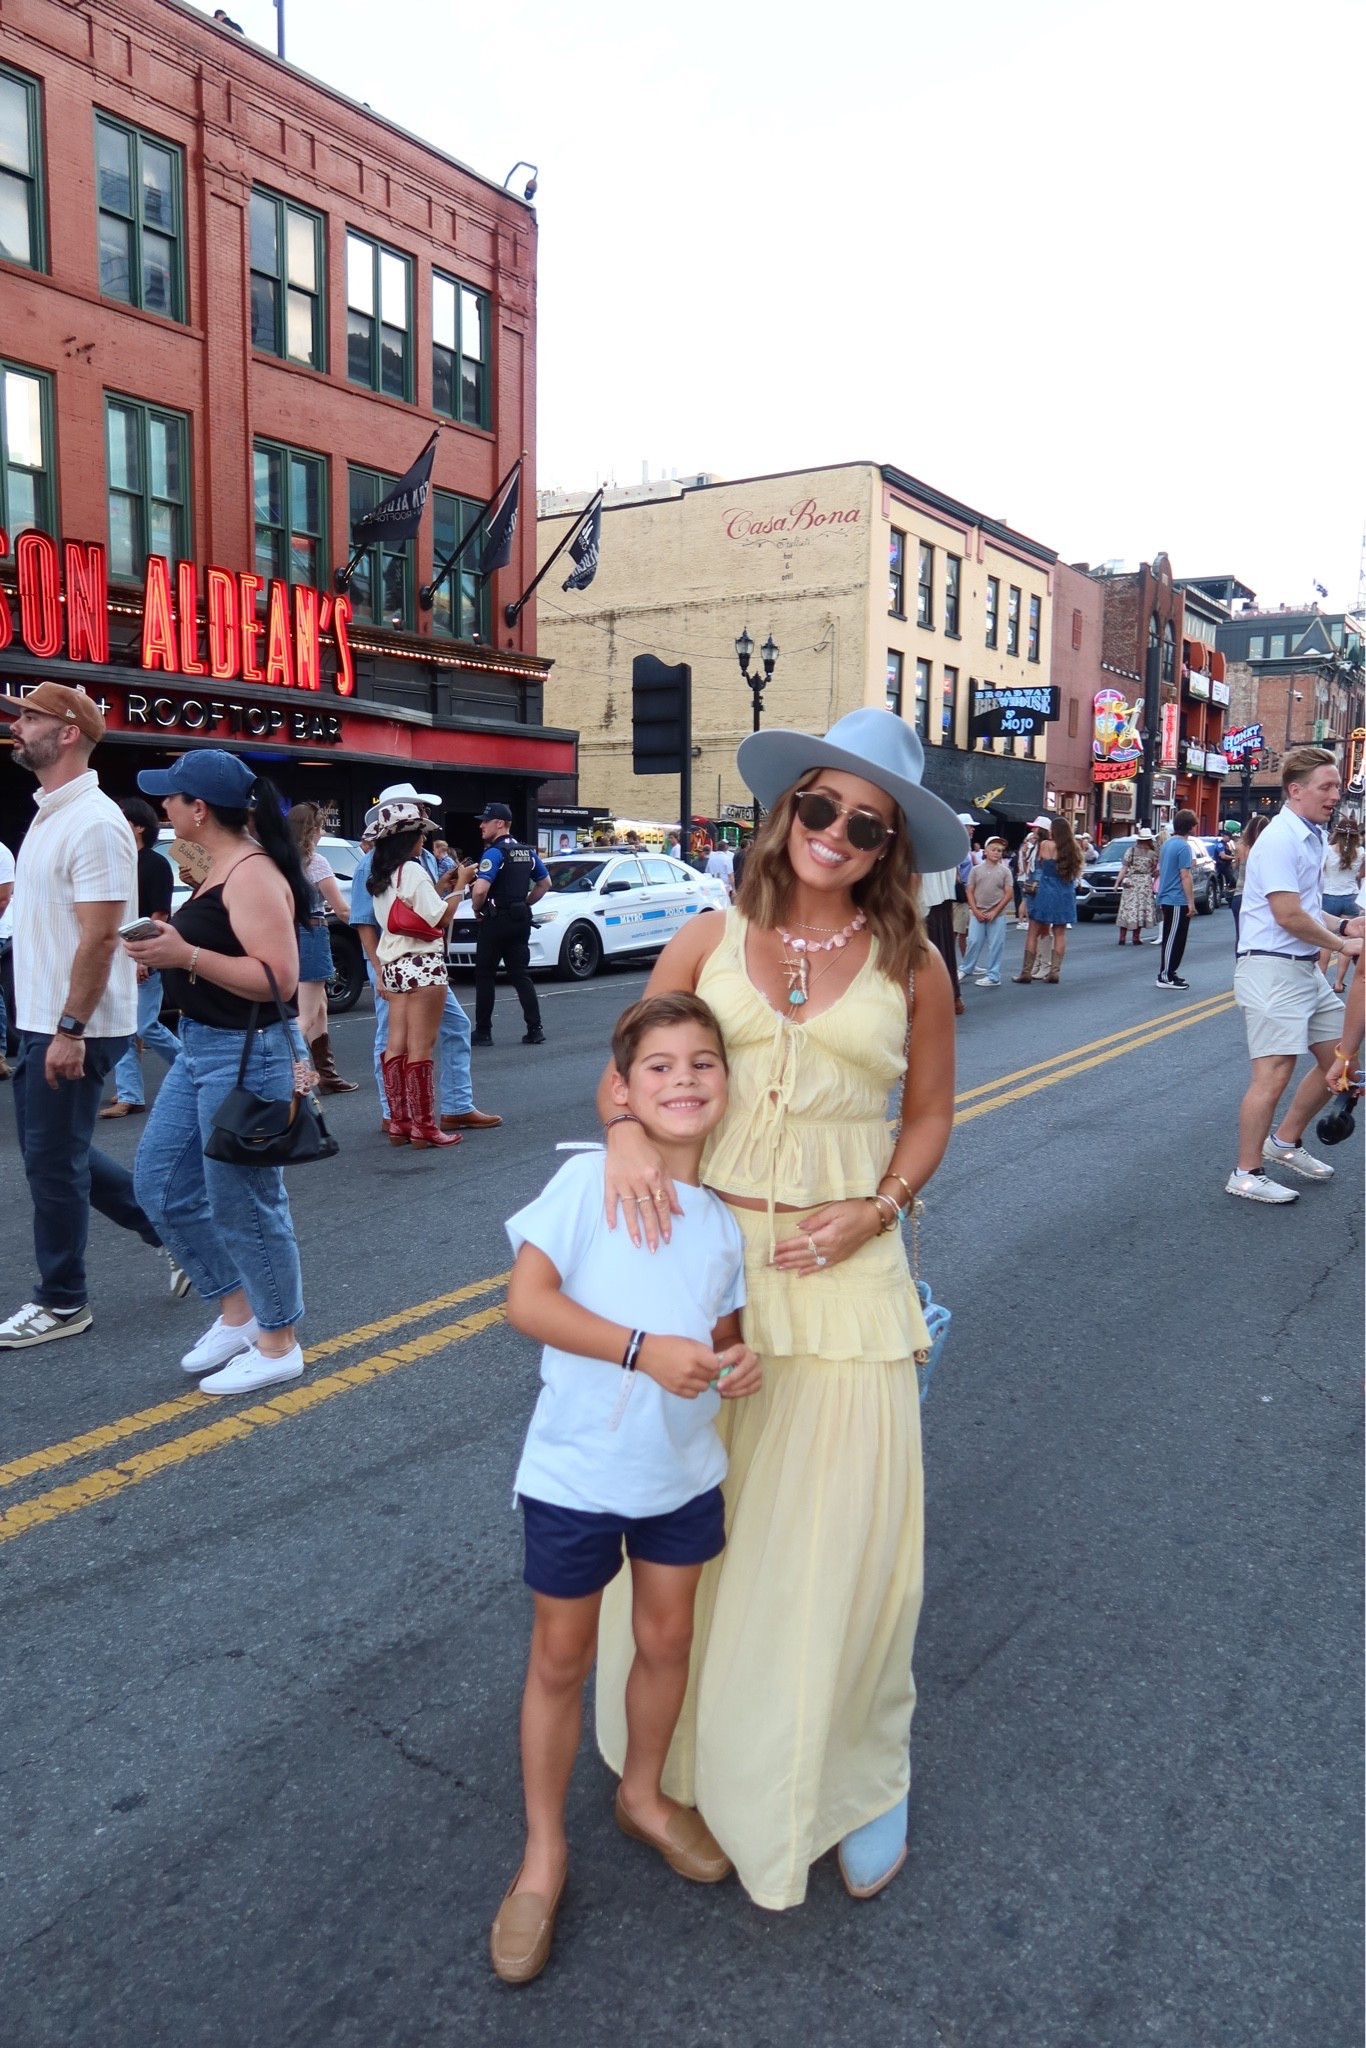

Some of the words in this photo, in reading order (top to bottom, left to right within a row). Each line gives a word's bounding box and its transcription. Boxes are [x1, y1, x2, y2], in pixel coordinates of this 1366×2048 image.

[722, 508, 788, 540] Casa
[789, 497, 861, 531] Bona
[783, 552, 794, 560] bar
[0, 528, 109, 663] ON
[142, 553, 357, 697] ALDEAN'S
[975, 688, 1052, 699] BROADWAY
[973, 695, 1051, 717] BREWHOUSE
[1005, 709, 1016, 719] &
[128, 694, 287, 737] ROOFTOP
[293, 713, 344, 744] BAR
[1000, 717, 1034, 735] MOJO
[1223, 724, 1260, 751] HONKY
[1094, 759, 1136, 771] BETTY
[1094, 769, 1134, 781] BOOTS
[515, 849, 530, 857] POLICE
[620, 913, 643, 924] METRO
[665, 906, 687, 917] POLICE
